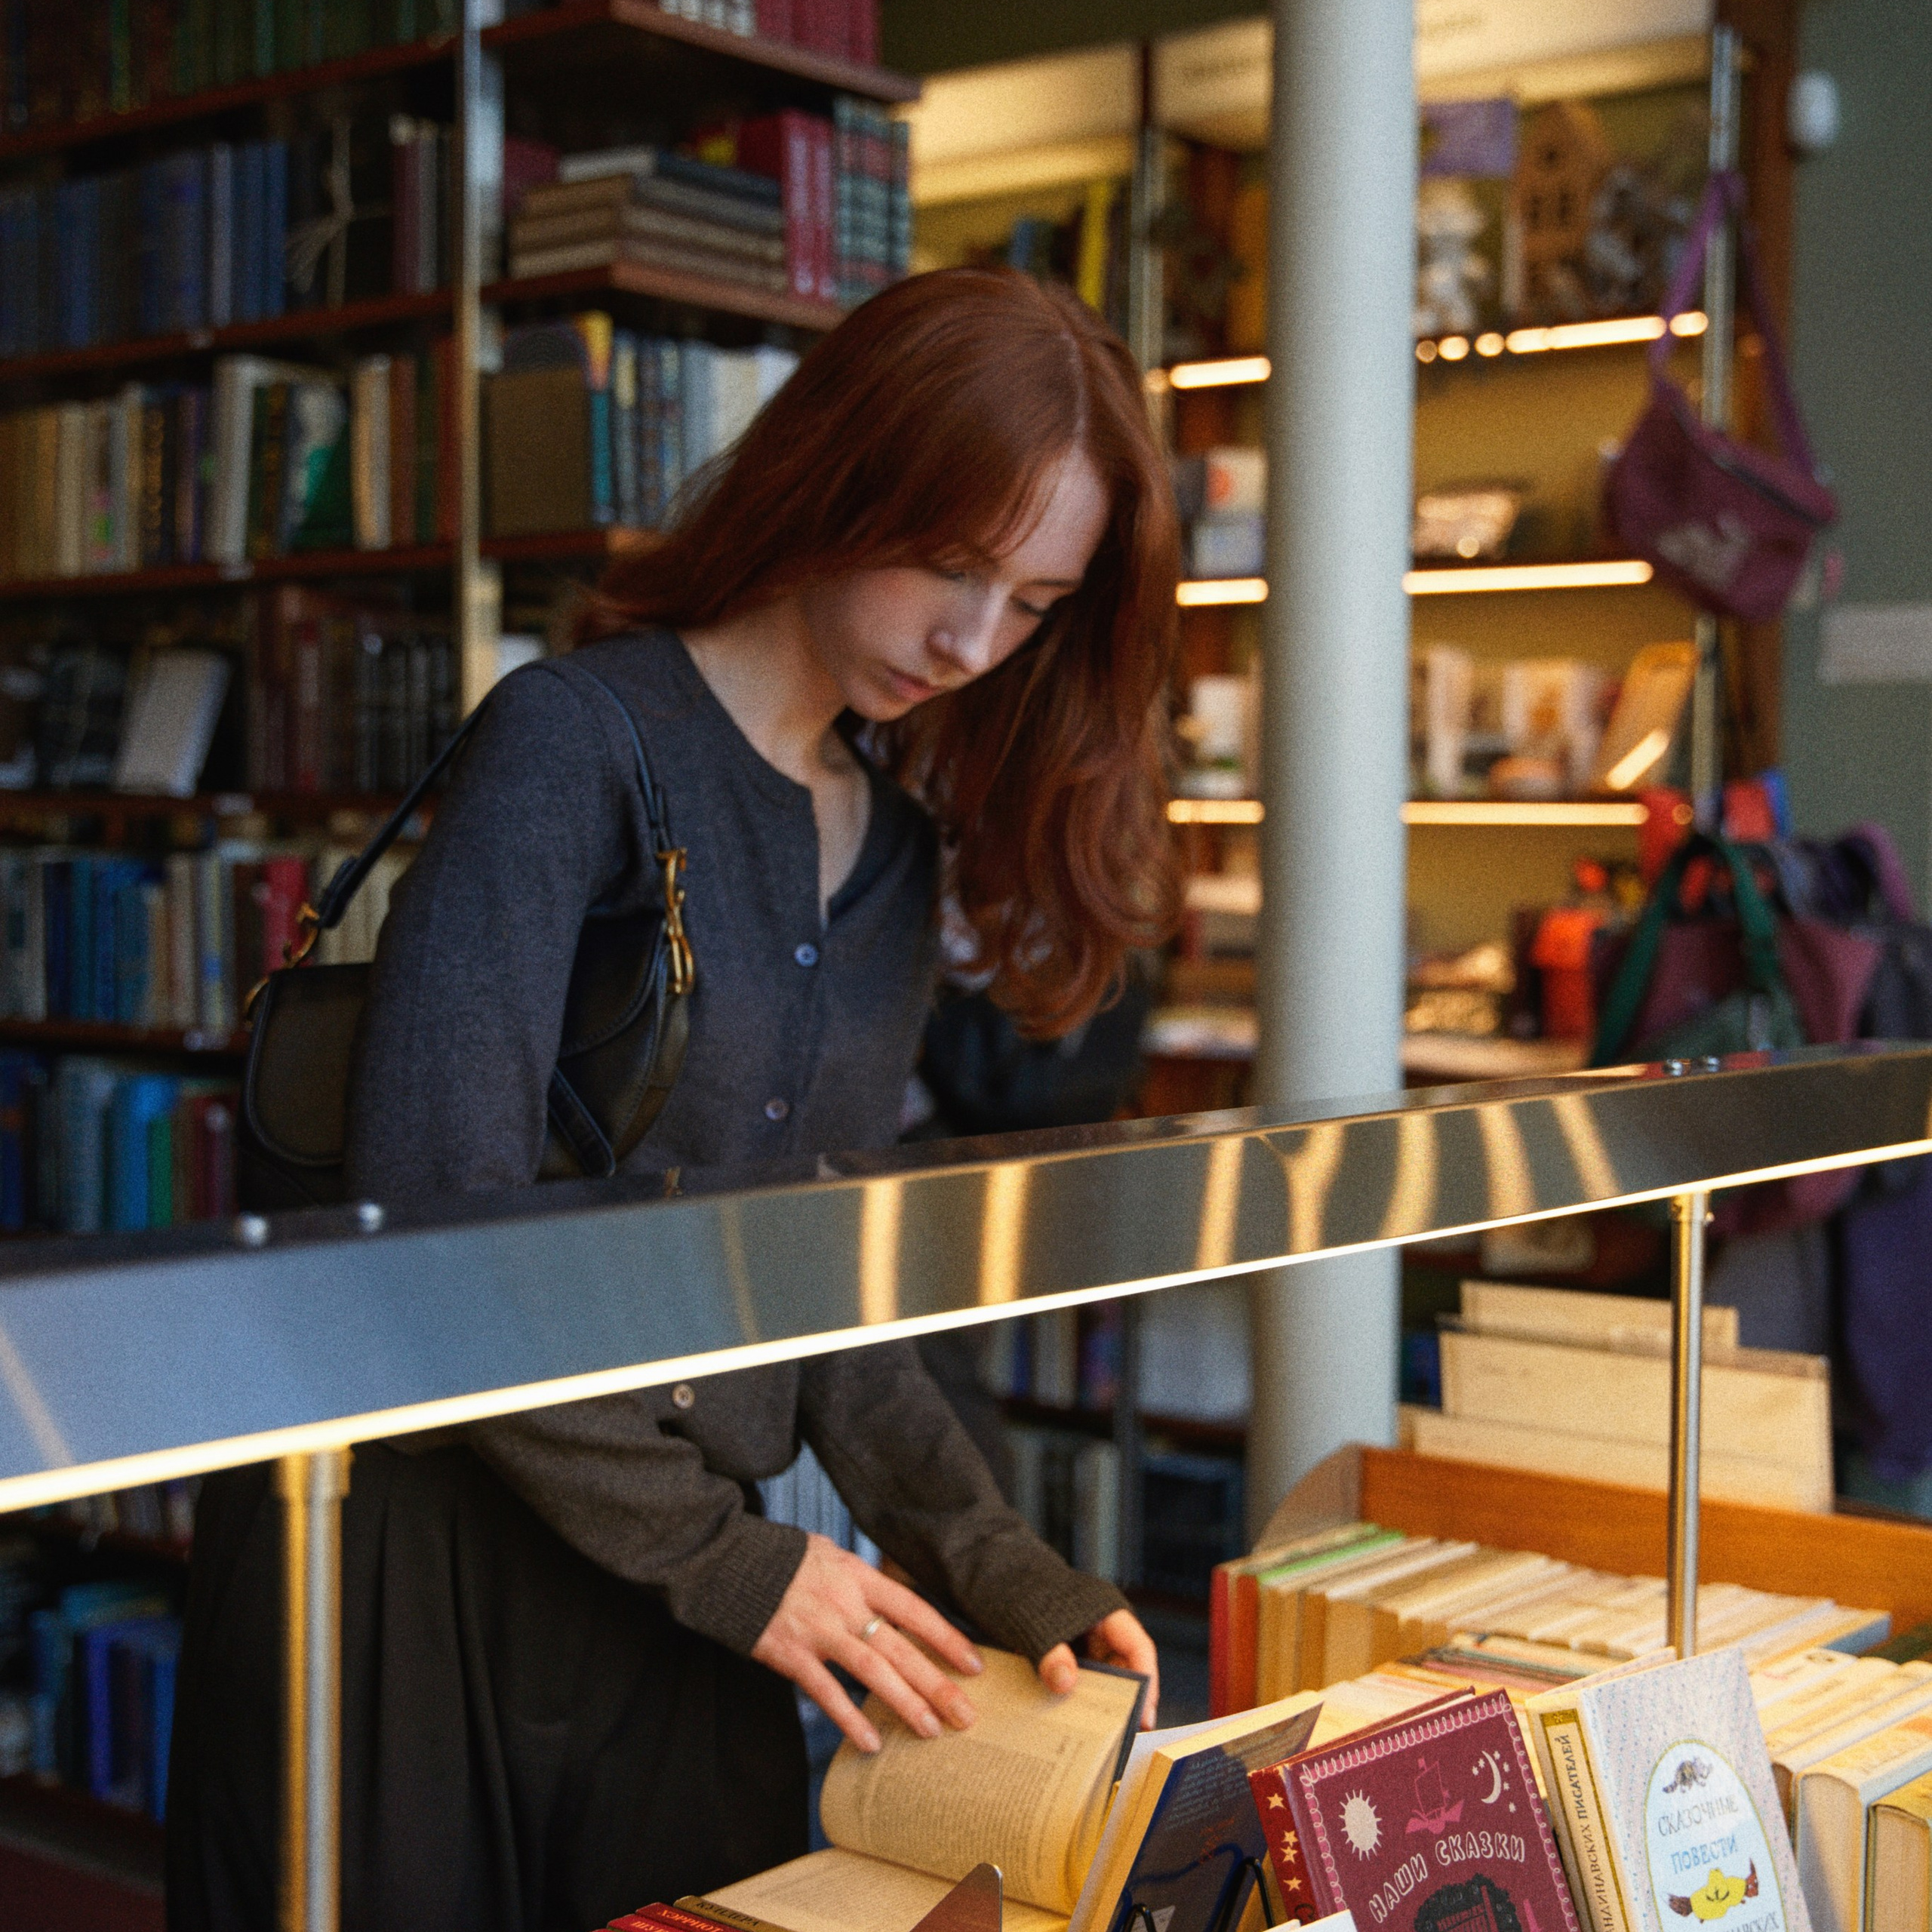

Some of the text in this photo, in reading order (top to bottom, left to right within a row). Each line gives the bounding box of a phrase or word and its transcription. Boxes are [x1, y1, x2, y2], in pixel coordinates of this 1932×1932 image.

[1555, 1734, 1589, 1820] ПИСАТЕЛЕЙ
[1368, 1853, 1429, 1924] НАШИ
[1435, 1831, 1525, 1866] СКАЗКИ
[1670, 1833, 1738, 1875] ПОВЕСТИ
[657, 1909, 724, 1932] ХЭРРИОТ
